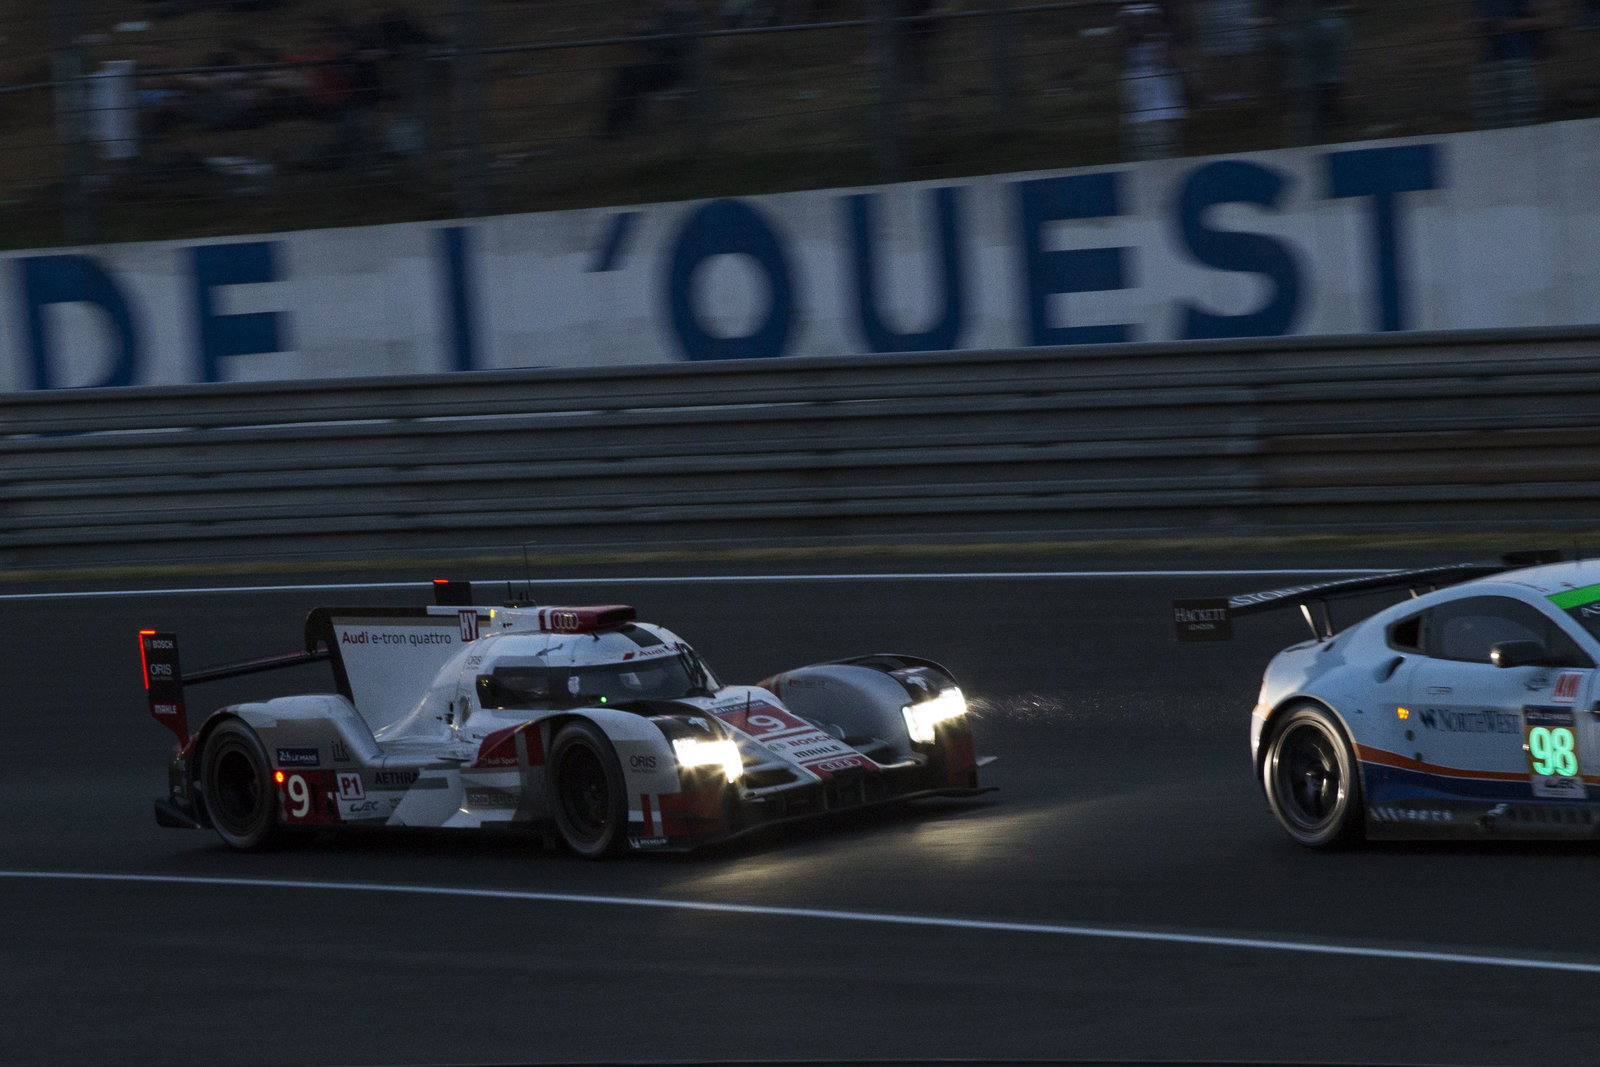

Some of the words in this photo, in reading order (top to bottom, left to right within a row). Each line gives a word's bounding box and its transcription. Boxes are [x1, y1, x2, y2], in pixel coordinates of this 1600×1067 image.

[1174, 608, 1227, 622] HACKETT
[460, 612, 477, 640] HY
[152, 639, 174, 649] BOSCH
[342, 631, 369, 645] Audi
[371, 632, 407, 645] e-tron
[408, 632, 452, 647] quattro
[149, 663, 173, 676] ORIS
[154, 704, 178, 715] MAHLE
[746, 714, 786, 733] 9
[1529, 726, 1579, 777] 98
[629, 755, 657, 769] ORIS
[375, 772, 420, 785] AETHRA
[341, 777, 361, 796] P1
[287, 774, 310, 818] 9
